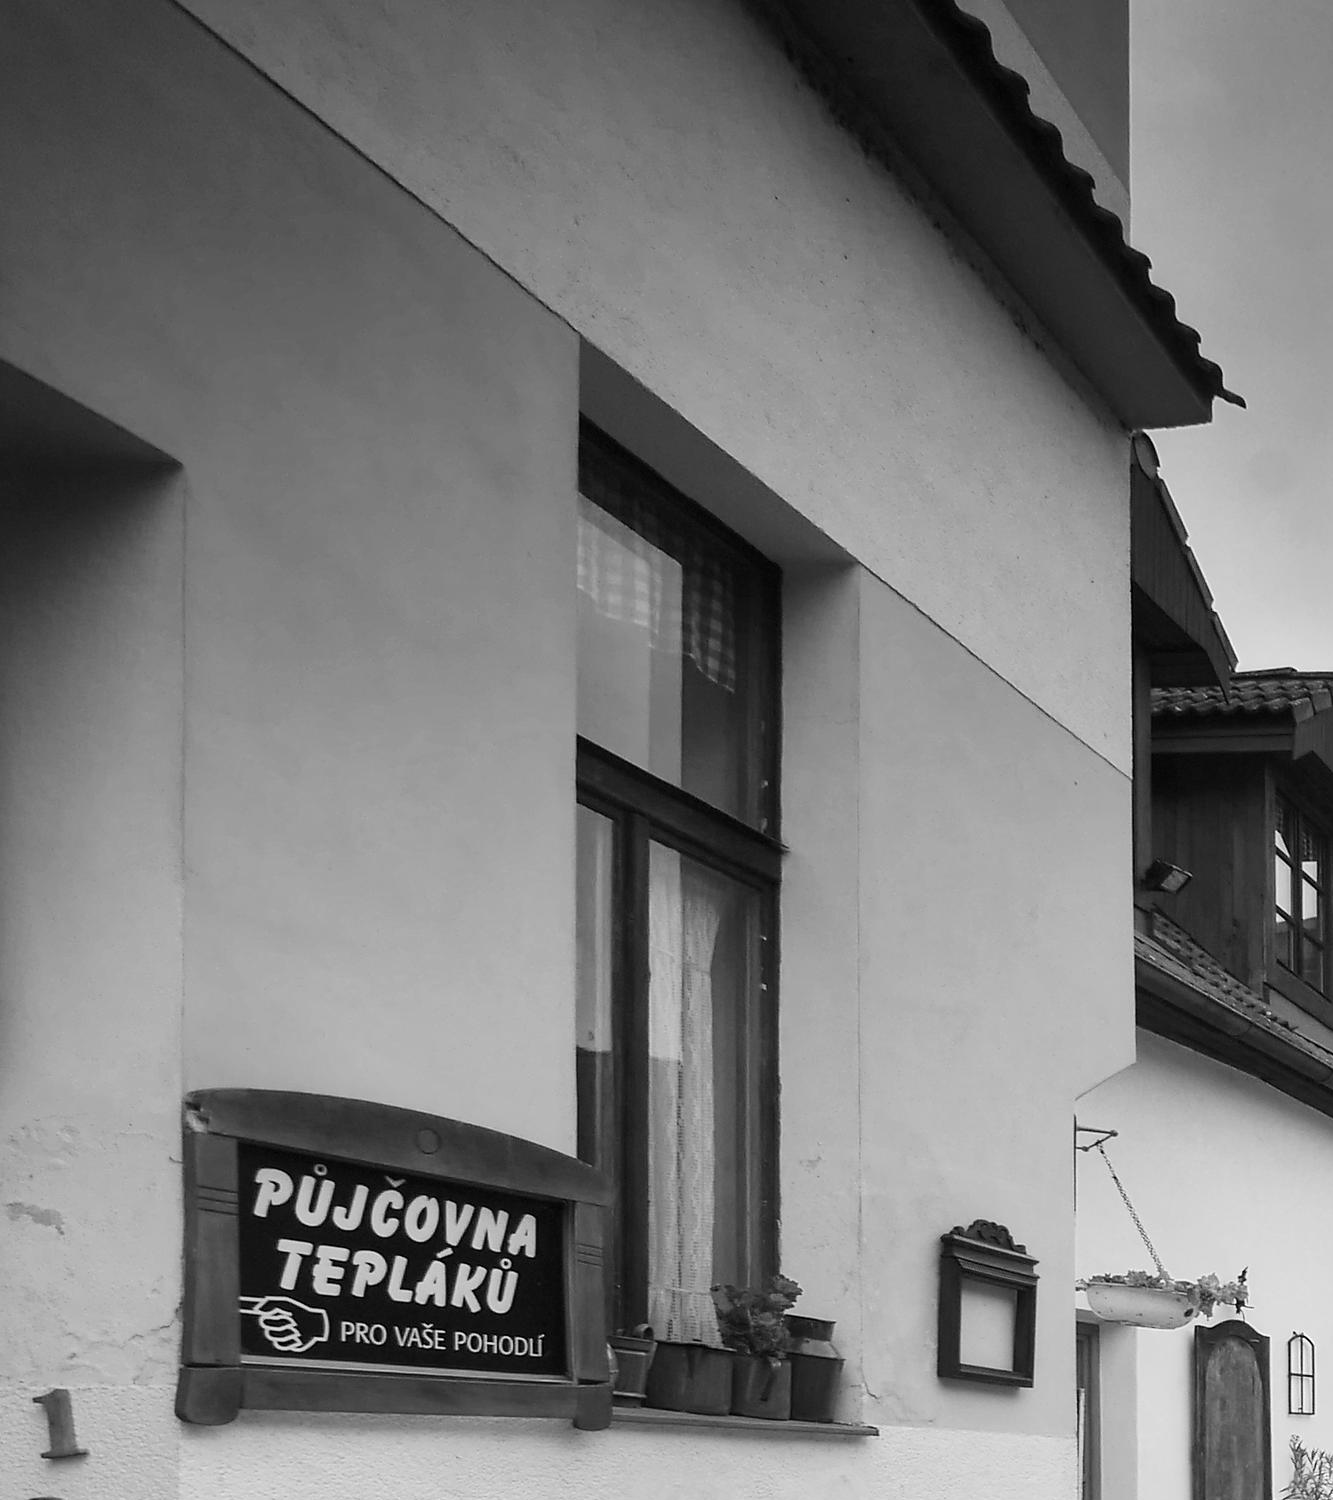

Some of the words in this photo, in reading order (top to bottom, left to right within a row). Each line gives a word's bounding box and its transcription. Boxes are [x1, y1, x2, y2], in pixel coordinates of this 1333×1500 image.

[252, 1164, 538, 1258] PŮJČOVNA
[277, 1239, 519, 1315] TEPLÁKŮ
[340, 1321, 387, 1346] PRO
[394, 1323, 447, 1351] VAŠE
[454, 1333, 546, 1358] POHODLÍ
